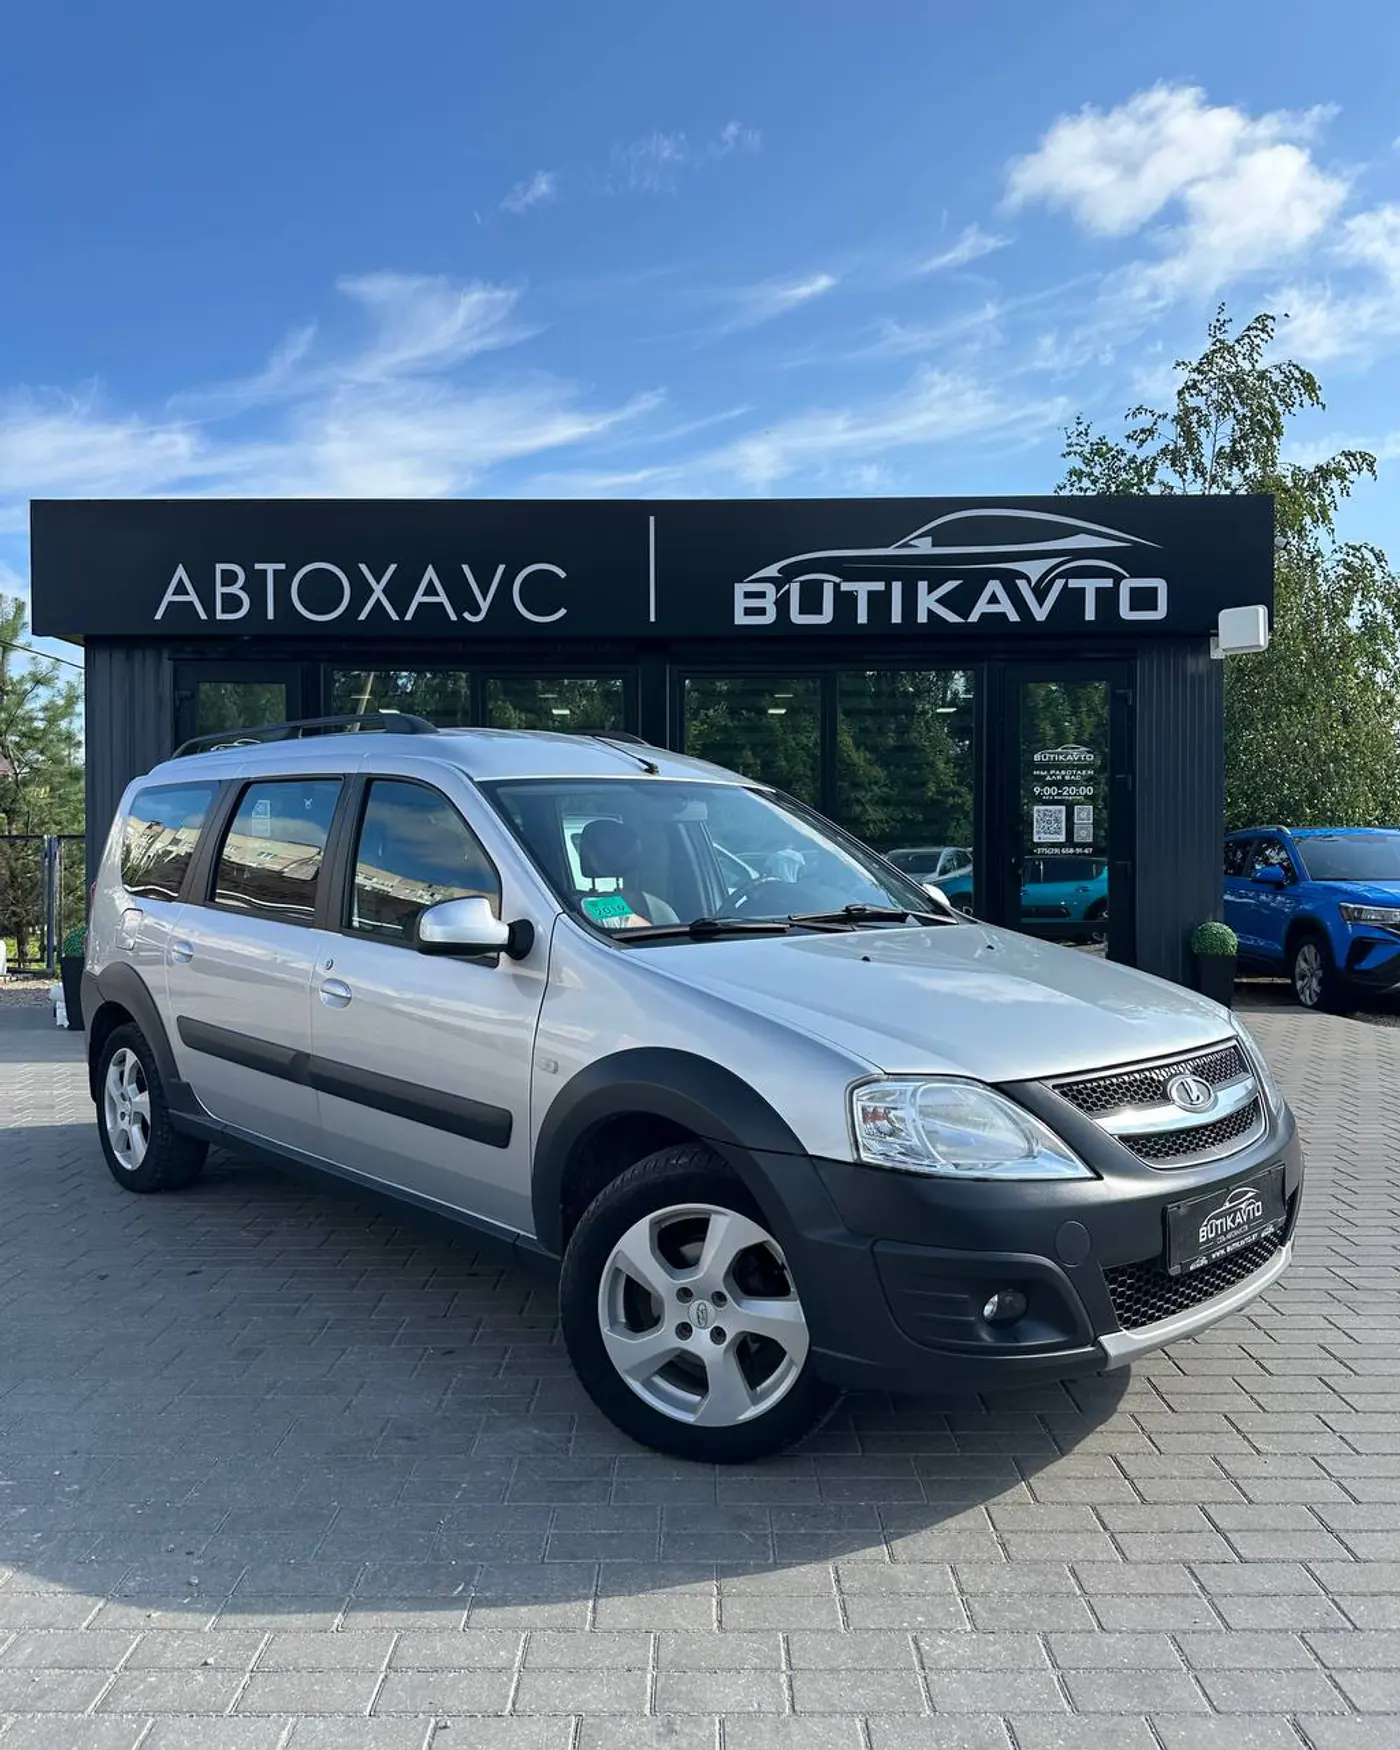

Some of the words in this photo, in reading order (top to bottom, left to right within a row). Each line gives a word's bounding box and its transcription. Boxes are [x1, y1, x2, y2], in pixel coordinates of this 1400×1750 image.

[154, 561, 567, 622] АВТОХАУС
[734, 577, 1168, 625] BUTIKAVTO
[1033, 753, 1094, 762] BUTIKAVTO
[1033, 786, 1094, 796] 9:00-20:00
[1199, 1201, 1262, 1243] BUTIKAVTO
